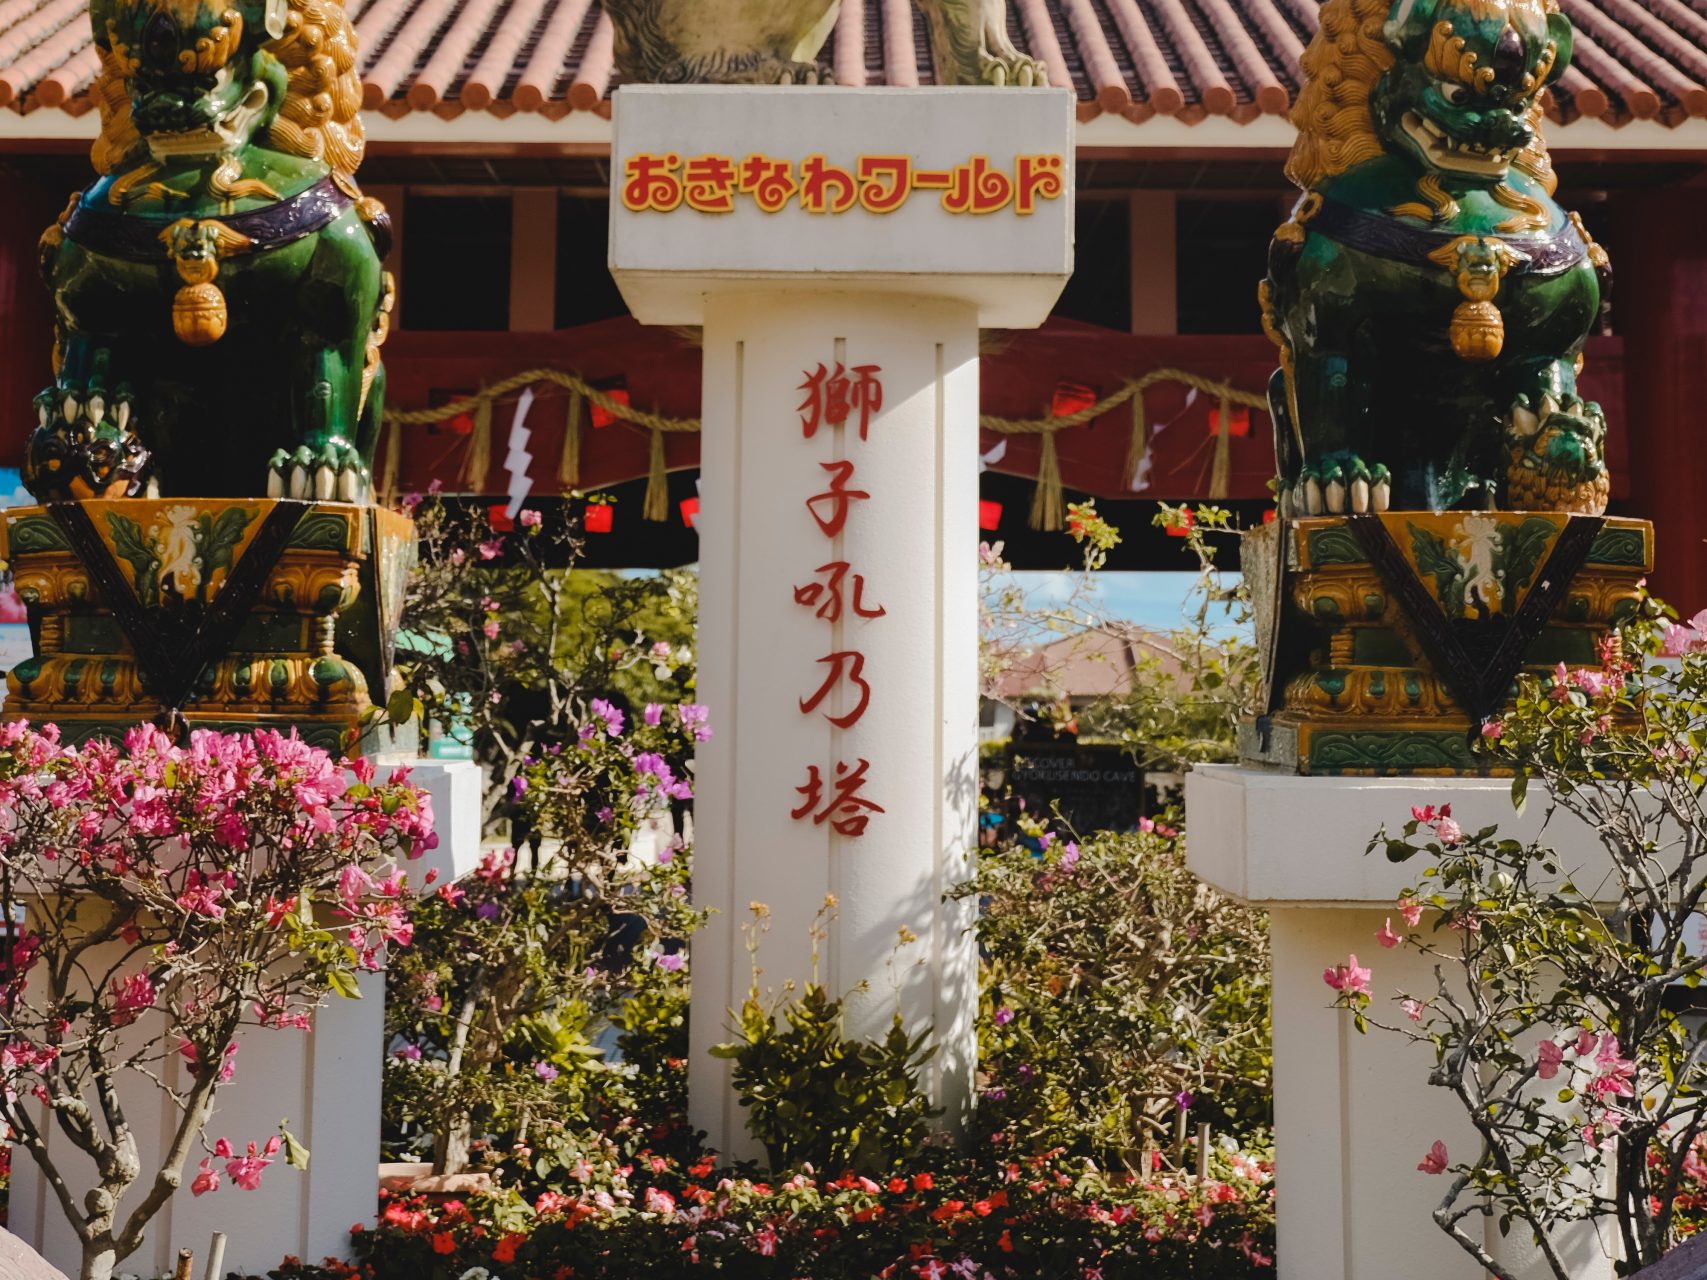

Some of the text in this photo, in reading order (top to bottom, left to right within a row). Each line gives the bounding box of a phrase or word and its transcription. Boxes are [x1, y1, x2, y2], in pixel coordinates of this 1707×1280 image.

[623, 154, 1064, 215] おきなわワールド
[792, 361, 887, 838] 獅子吼乃塔
[1103, 770, 1136, 783] CAVE
